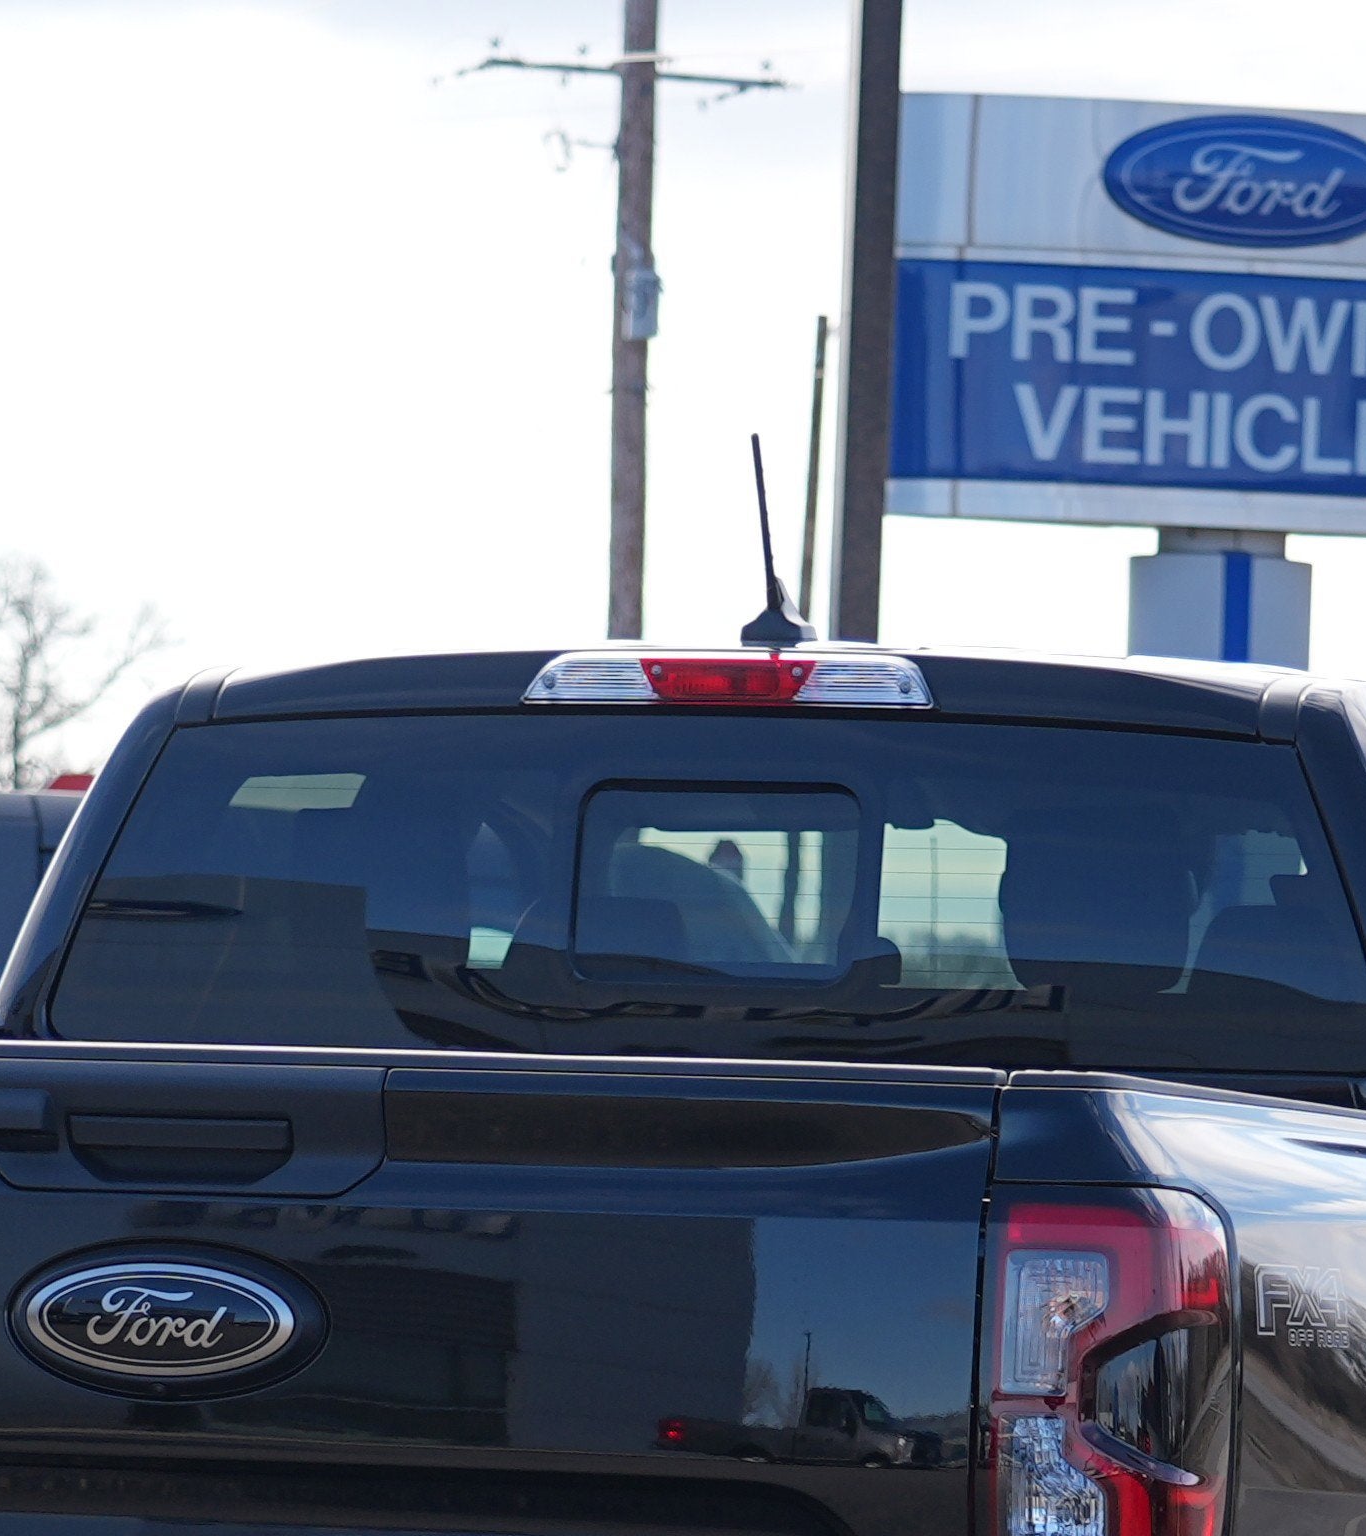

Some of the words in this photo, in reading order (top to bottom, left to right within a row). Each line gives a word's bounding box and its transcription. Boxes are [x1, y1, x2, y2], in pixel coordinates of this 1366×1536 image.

[1172, 141, 1348, 220] Ford
[86, 1285, 228, 1349] Ford
[1253, 1263, 1350, 1336] FX4
